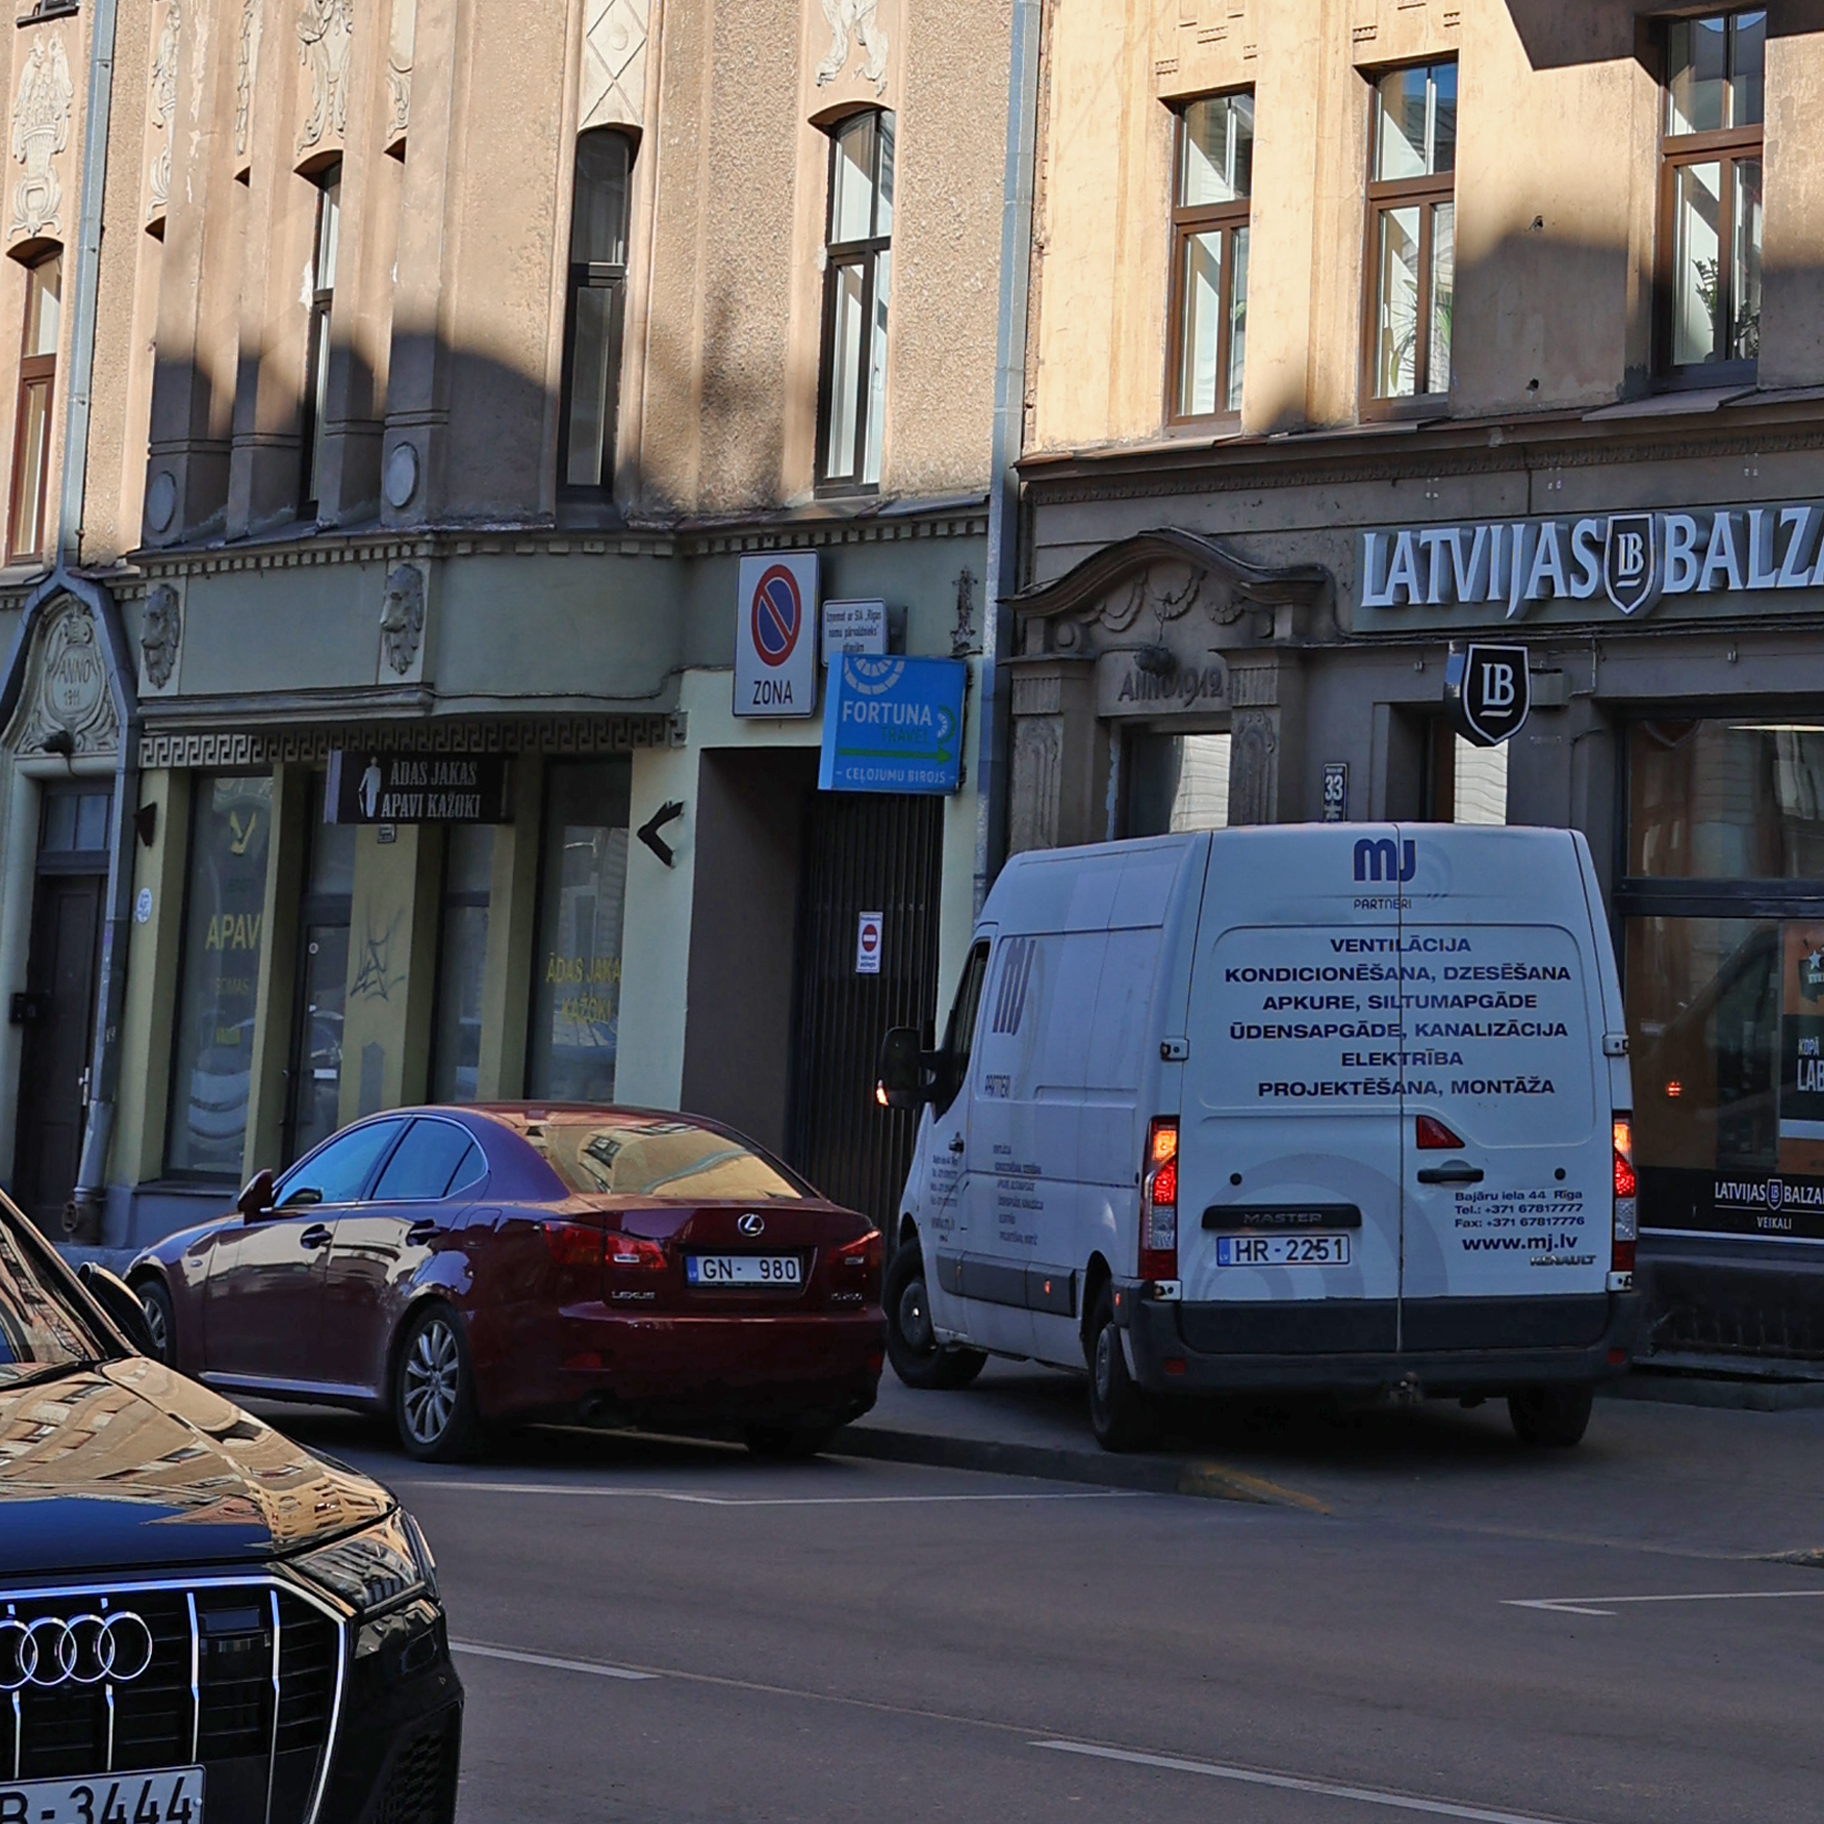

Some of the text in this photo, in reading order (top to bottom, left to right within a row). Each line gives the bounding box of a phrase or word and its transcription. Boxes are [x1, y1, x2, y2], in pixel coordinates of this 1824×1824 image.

[1361, 517, 1600, 619] LATVIJAS
[57, 658, 92, 684] ANNO
[752, 680, 793, 705] ZONA
[1481, 662, 1515, 705] LB
[842, 701, 932, 726] FORTUNA
[880, 727, 929, 744] TRAVEL
[390, 758, 478, 786] ĀDAS JAKAS
[846, 767, 946, 784] CEĻOJUMU BIROJS
[1325, 774, 1344, 801] 33
[381, 791, 481, 818] APAVI KAŽOKI
[1353, 898, 1412, 910] PARTNERI
[1330, 935, 1472, 953] VENTILĀCIJA
[545, 951, 584, 984] ĀDAS
[1225, 962, 1572, 984] KONDICIONĒŠANA, DZESĒŠANA
[1262, 991, 1538, 1013] APKURE, SILTUMAPGĀDE
[1229, 1019, 1569, 1041] ŪDENSAPGĀDE, KANALIZĀCIJA
[1341, 1048, 1464, 1067] ELEKTRĪBA
[1258, 1075, 1555, 1098] PROJEKTĒŠANA, MONTĀŽA
[1454, 1190, 1583, 1203] Bajāru iela 44 Rīga
[1714, 1181, 1766, 1203] LATVIJAS
[1243, 1212, 1322, 1224] MASTER
[1454, 1203, 1584, 1215] Tel.: +371 67817777
[1454, 1216, 1586, 1229] Fax: +371 67817776
[1756, 1216, 1792, 1230] VEIKALI
[1235, 1238, 1343, 1263] HR-2251
[1461, 1233, 1578, 1252] www.mj.lv
[1529, 1254, 1597, 1267] RENAULT
[611, 1290, 655, 1300] LEXUS
